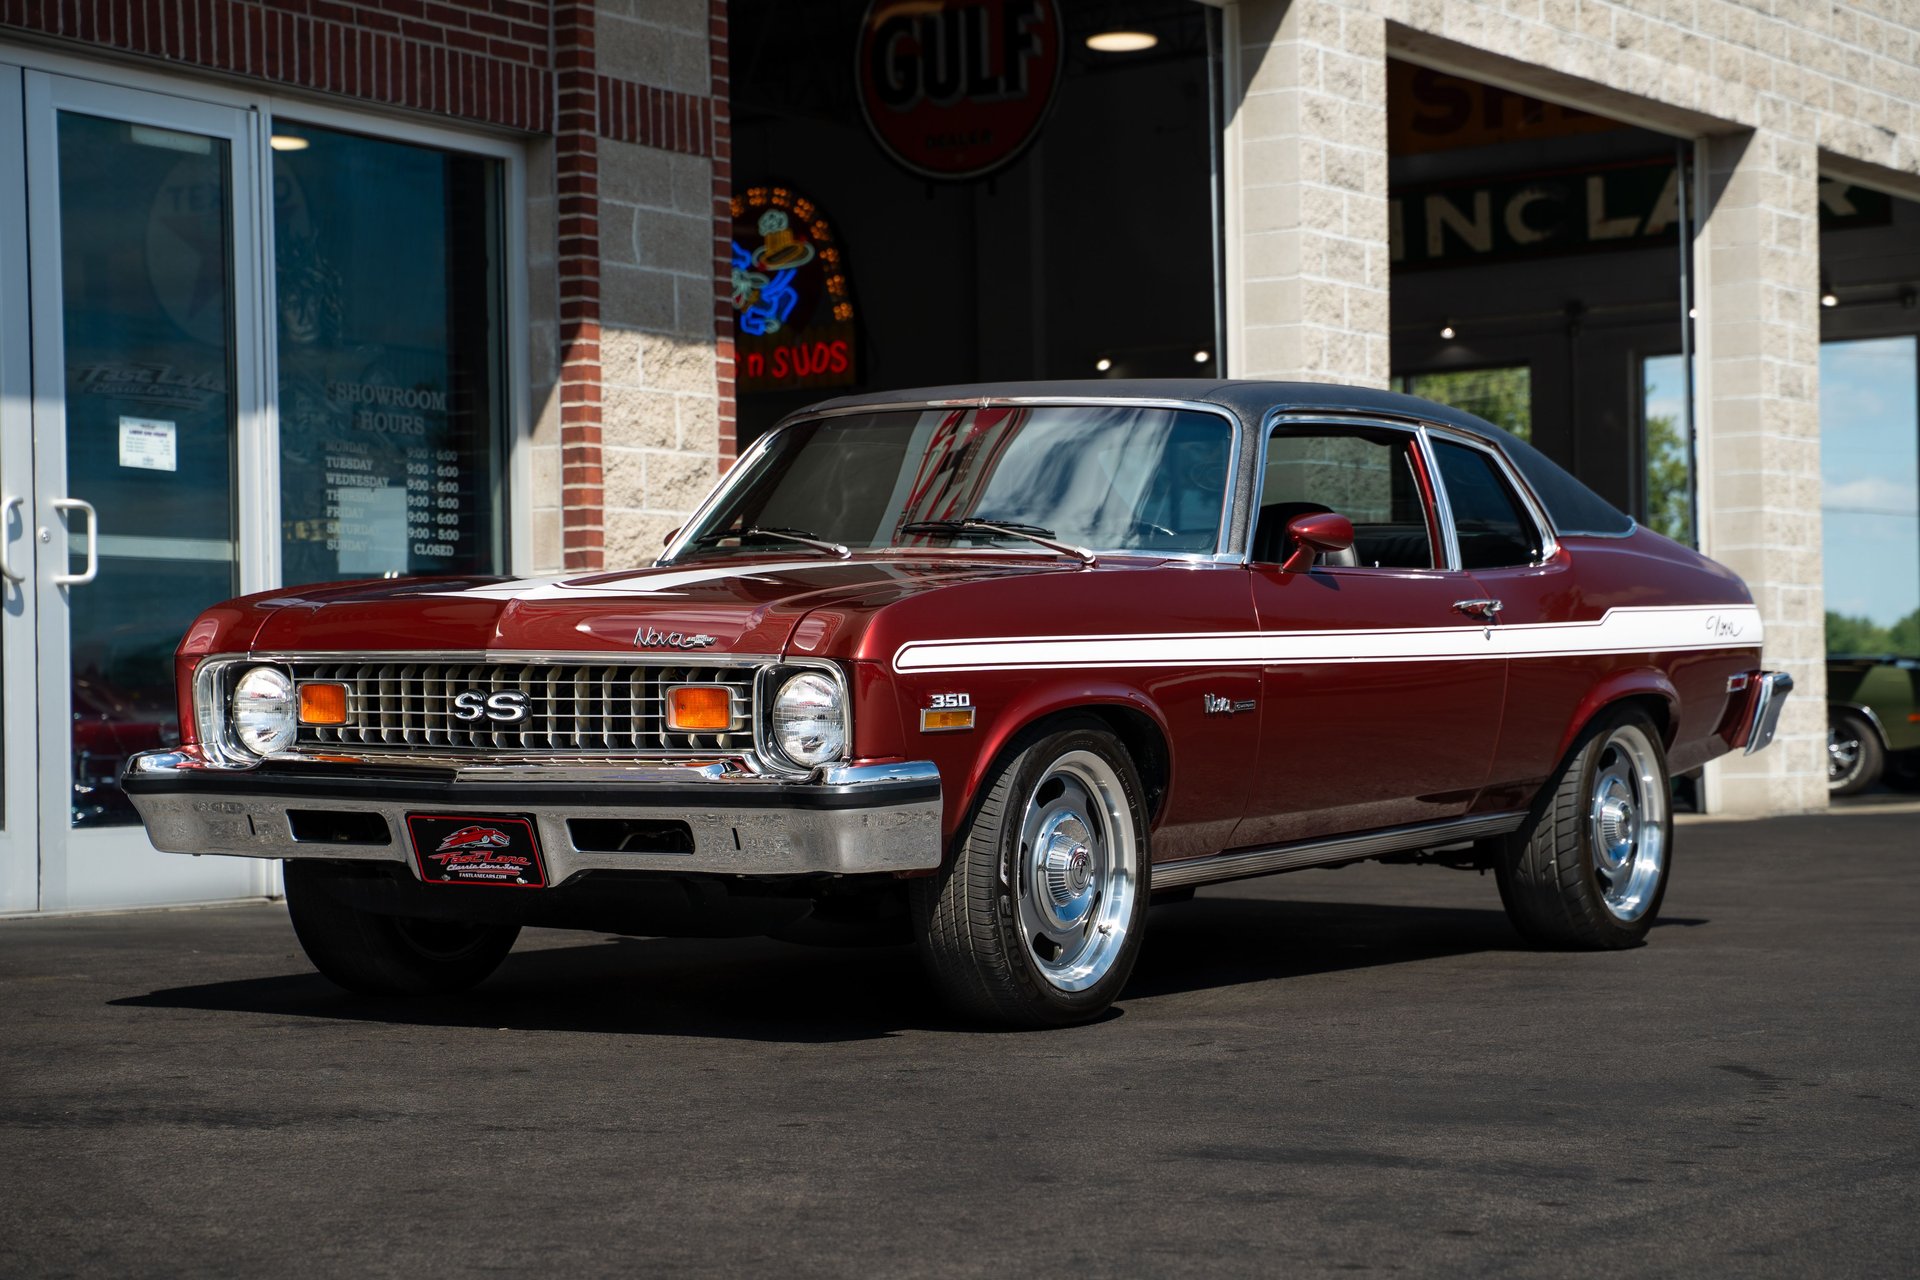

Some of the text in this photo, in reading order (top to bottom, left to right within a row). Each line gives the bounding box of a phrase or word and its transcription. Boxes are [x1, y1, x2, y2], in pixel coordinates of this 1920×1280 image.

[875, 2, 1044, 112] GULF
[772, 340, 849, 379] SUDS
[335, 383, 447, 411] SHOWROOM
[358, 410, 425, 435] HOURS
[325, 457, 374, 471] TUESDAY
[406, 463, 428, 475] 9:00
[436, 465, 459, 478] 6:00
[325, 472, 390, 488] WEDNESDAY
[406, 479, 428, 491] 9:00
[436, 481, 459, 494] 6:00
[407, 495, 429, 507] 9:00
[437, 497, 459, 510] 6:00
[326, 506, 364, 519] FRIDAY
[407, 511, 429, 523] 9:00
[437, 513, 459, 526] 6:00
[407, 527, 429, 539] 9:00
[437, 529, 460, 542] 5:00
[326, 539, 454, 557] SUNDAY CLOSED
[633, 626, 693, 649] Nova
[454, 689, 529, 723] SS
[930, 693, 970, 708] 350
[428, 850, 531, 866] Fast Lane
[446, 863, 478, 871] Classic
